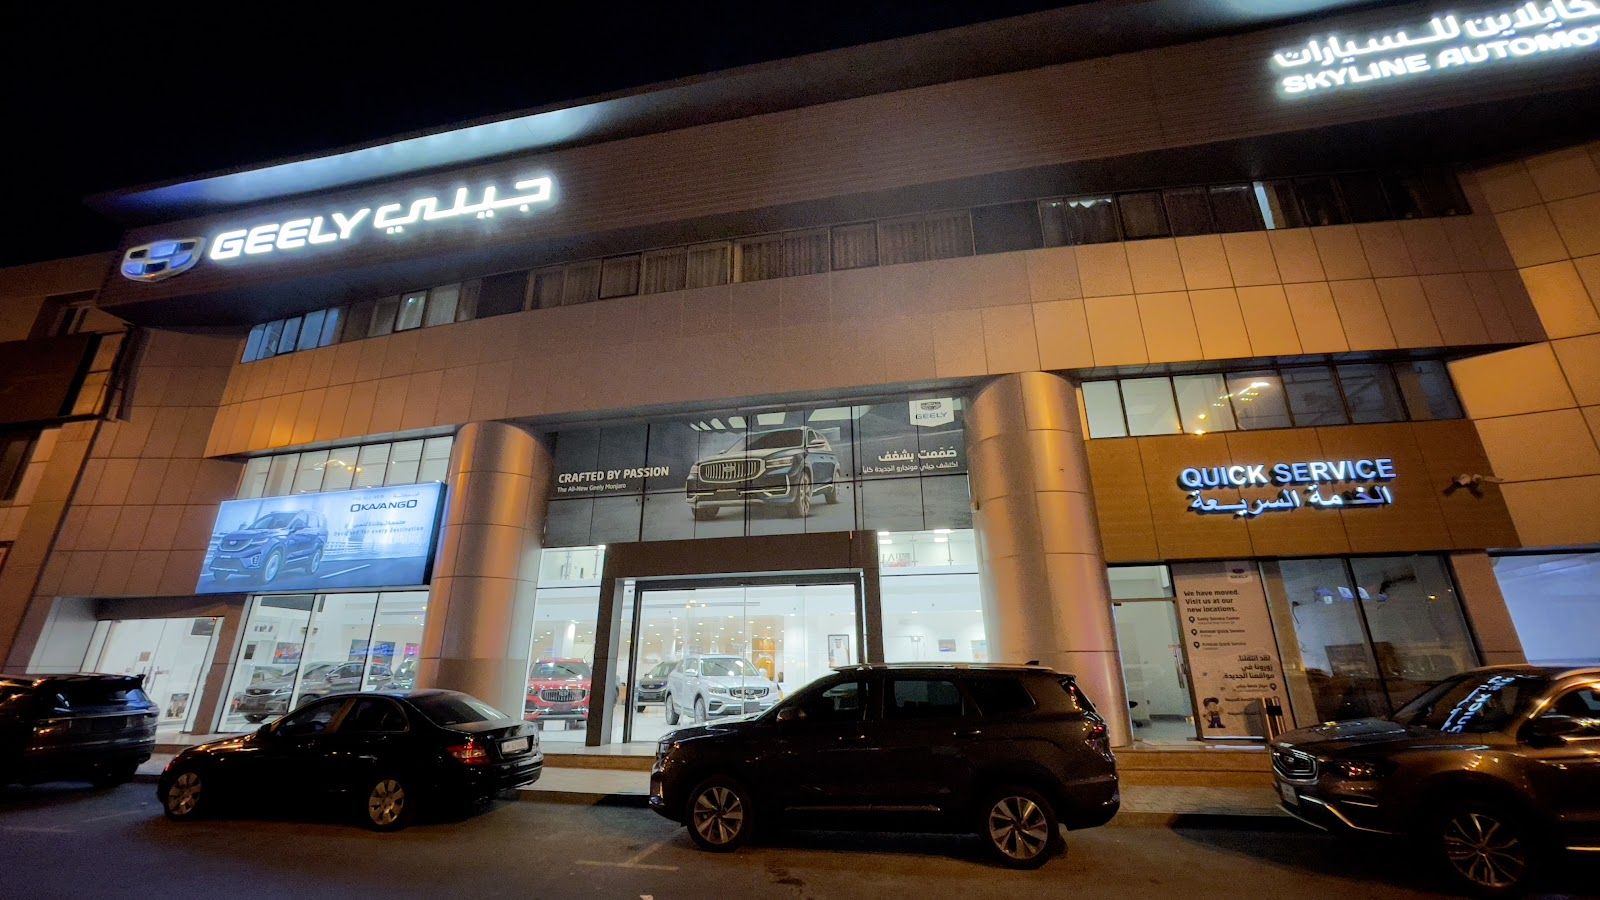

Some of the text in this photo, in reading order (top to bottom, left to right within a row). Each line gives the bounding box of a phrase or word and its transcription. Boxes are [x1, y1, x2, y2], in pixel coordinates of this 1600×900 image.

[1273, 0, 1600, 67] كايلاين للسيارات
[1281, 53, 1432, 93] SKYLINE
[373, 176, 553, 235] جيلي
[209, 208, 371, 261] GEELY
[916, 412, 948, 420] GEELY
[878, 449, 915, 462] بشغف
[558, 466, 670, 484] CRAFTED BY PASSION
[605, 483, 627, 491] Monjaro
[1181, 458, 1396, 488] QUICK SERVICE
[350, 499, 418, 512] OKAVANGO
[1190, 488, 1301, 517] السريعة
